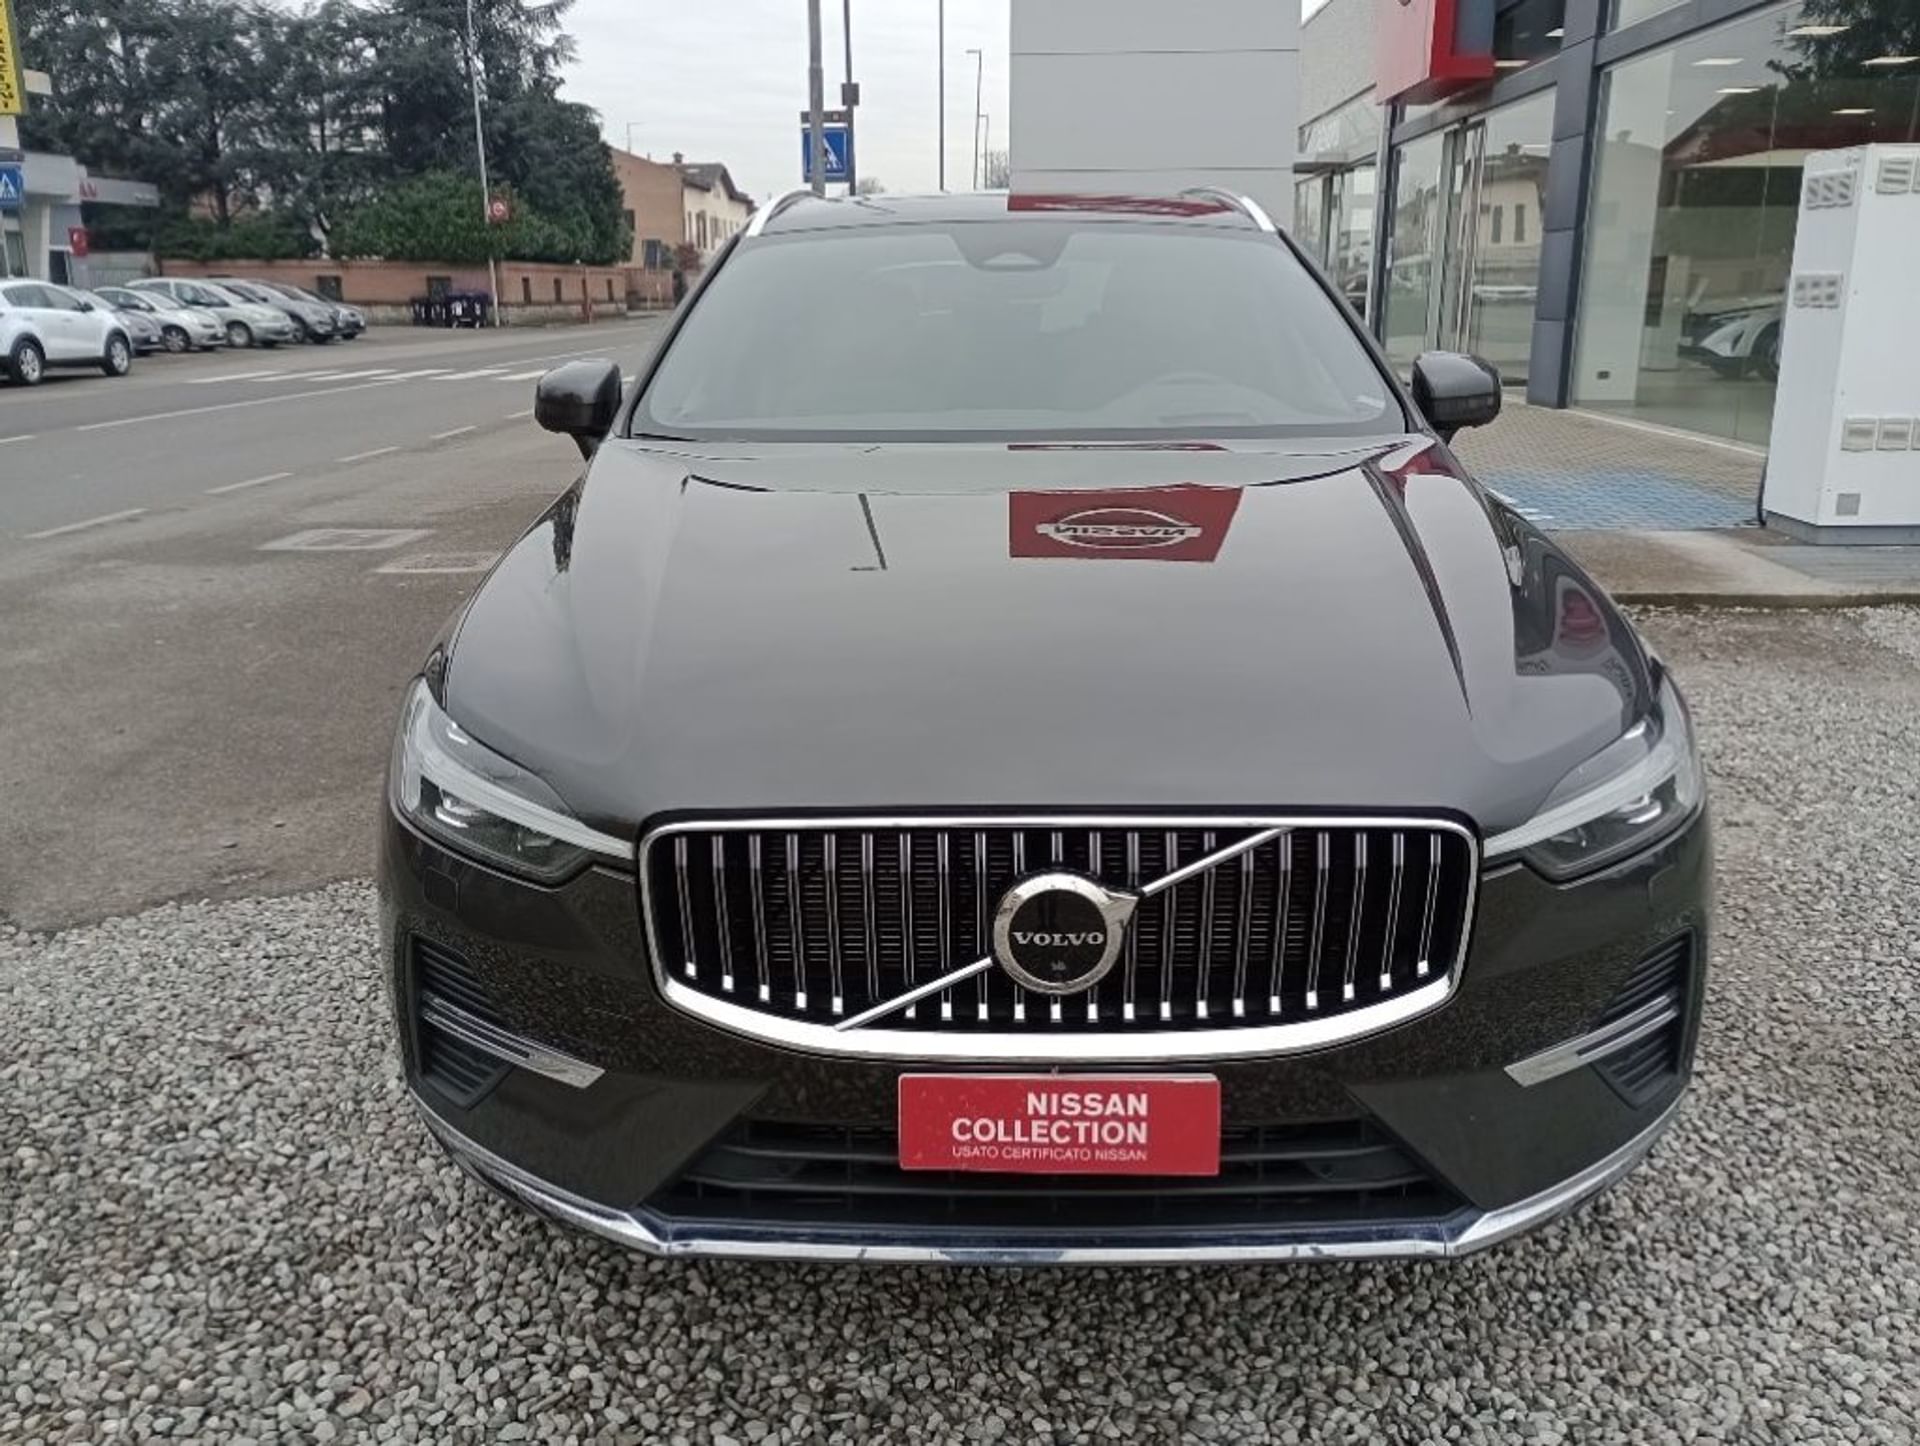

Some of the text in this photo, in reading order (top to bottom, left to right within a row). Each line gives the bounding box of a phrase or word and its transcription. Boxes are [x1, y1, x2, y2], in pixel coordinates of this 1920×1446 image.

[1012, 932, 1104, 946] VOLVO
[1027, 1093, 1147, 1116] NISSAN
[952, 1118, 1147, 1144] COLLECTION
[952, 1146, 1147, 1162] USATO CERTIFICATO NISSAN
